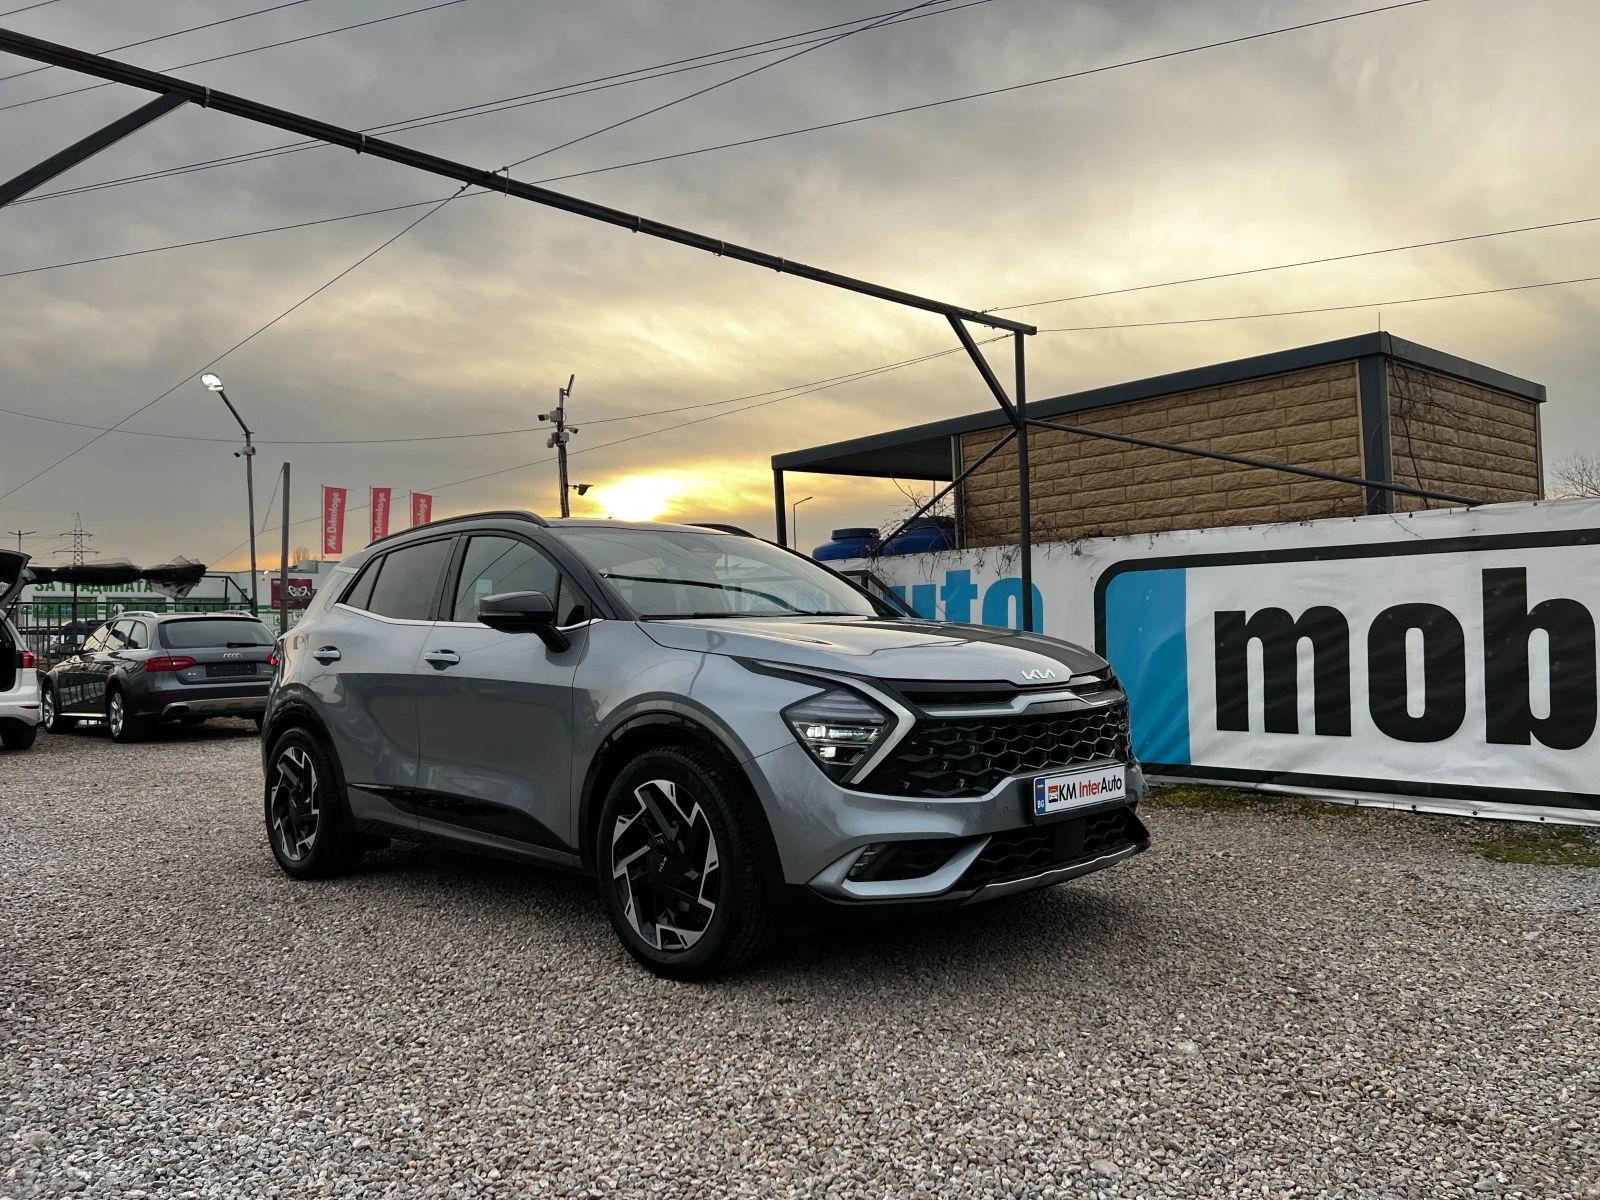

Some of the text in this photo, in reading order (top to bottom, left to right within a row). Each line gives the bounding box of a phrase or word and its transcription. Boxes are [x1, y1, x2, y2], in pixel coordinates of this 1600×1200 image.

[1214, 566, 1598, 750] mob
[1021, 669, 1056, 680] KIA
[1059, 775, 1122, 802] KM InterAuto
[1037, 799, 1045, 808] BG
